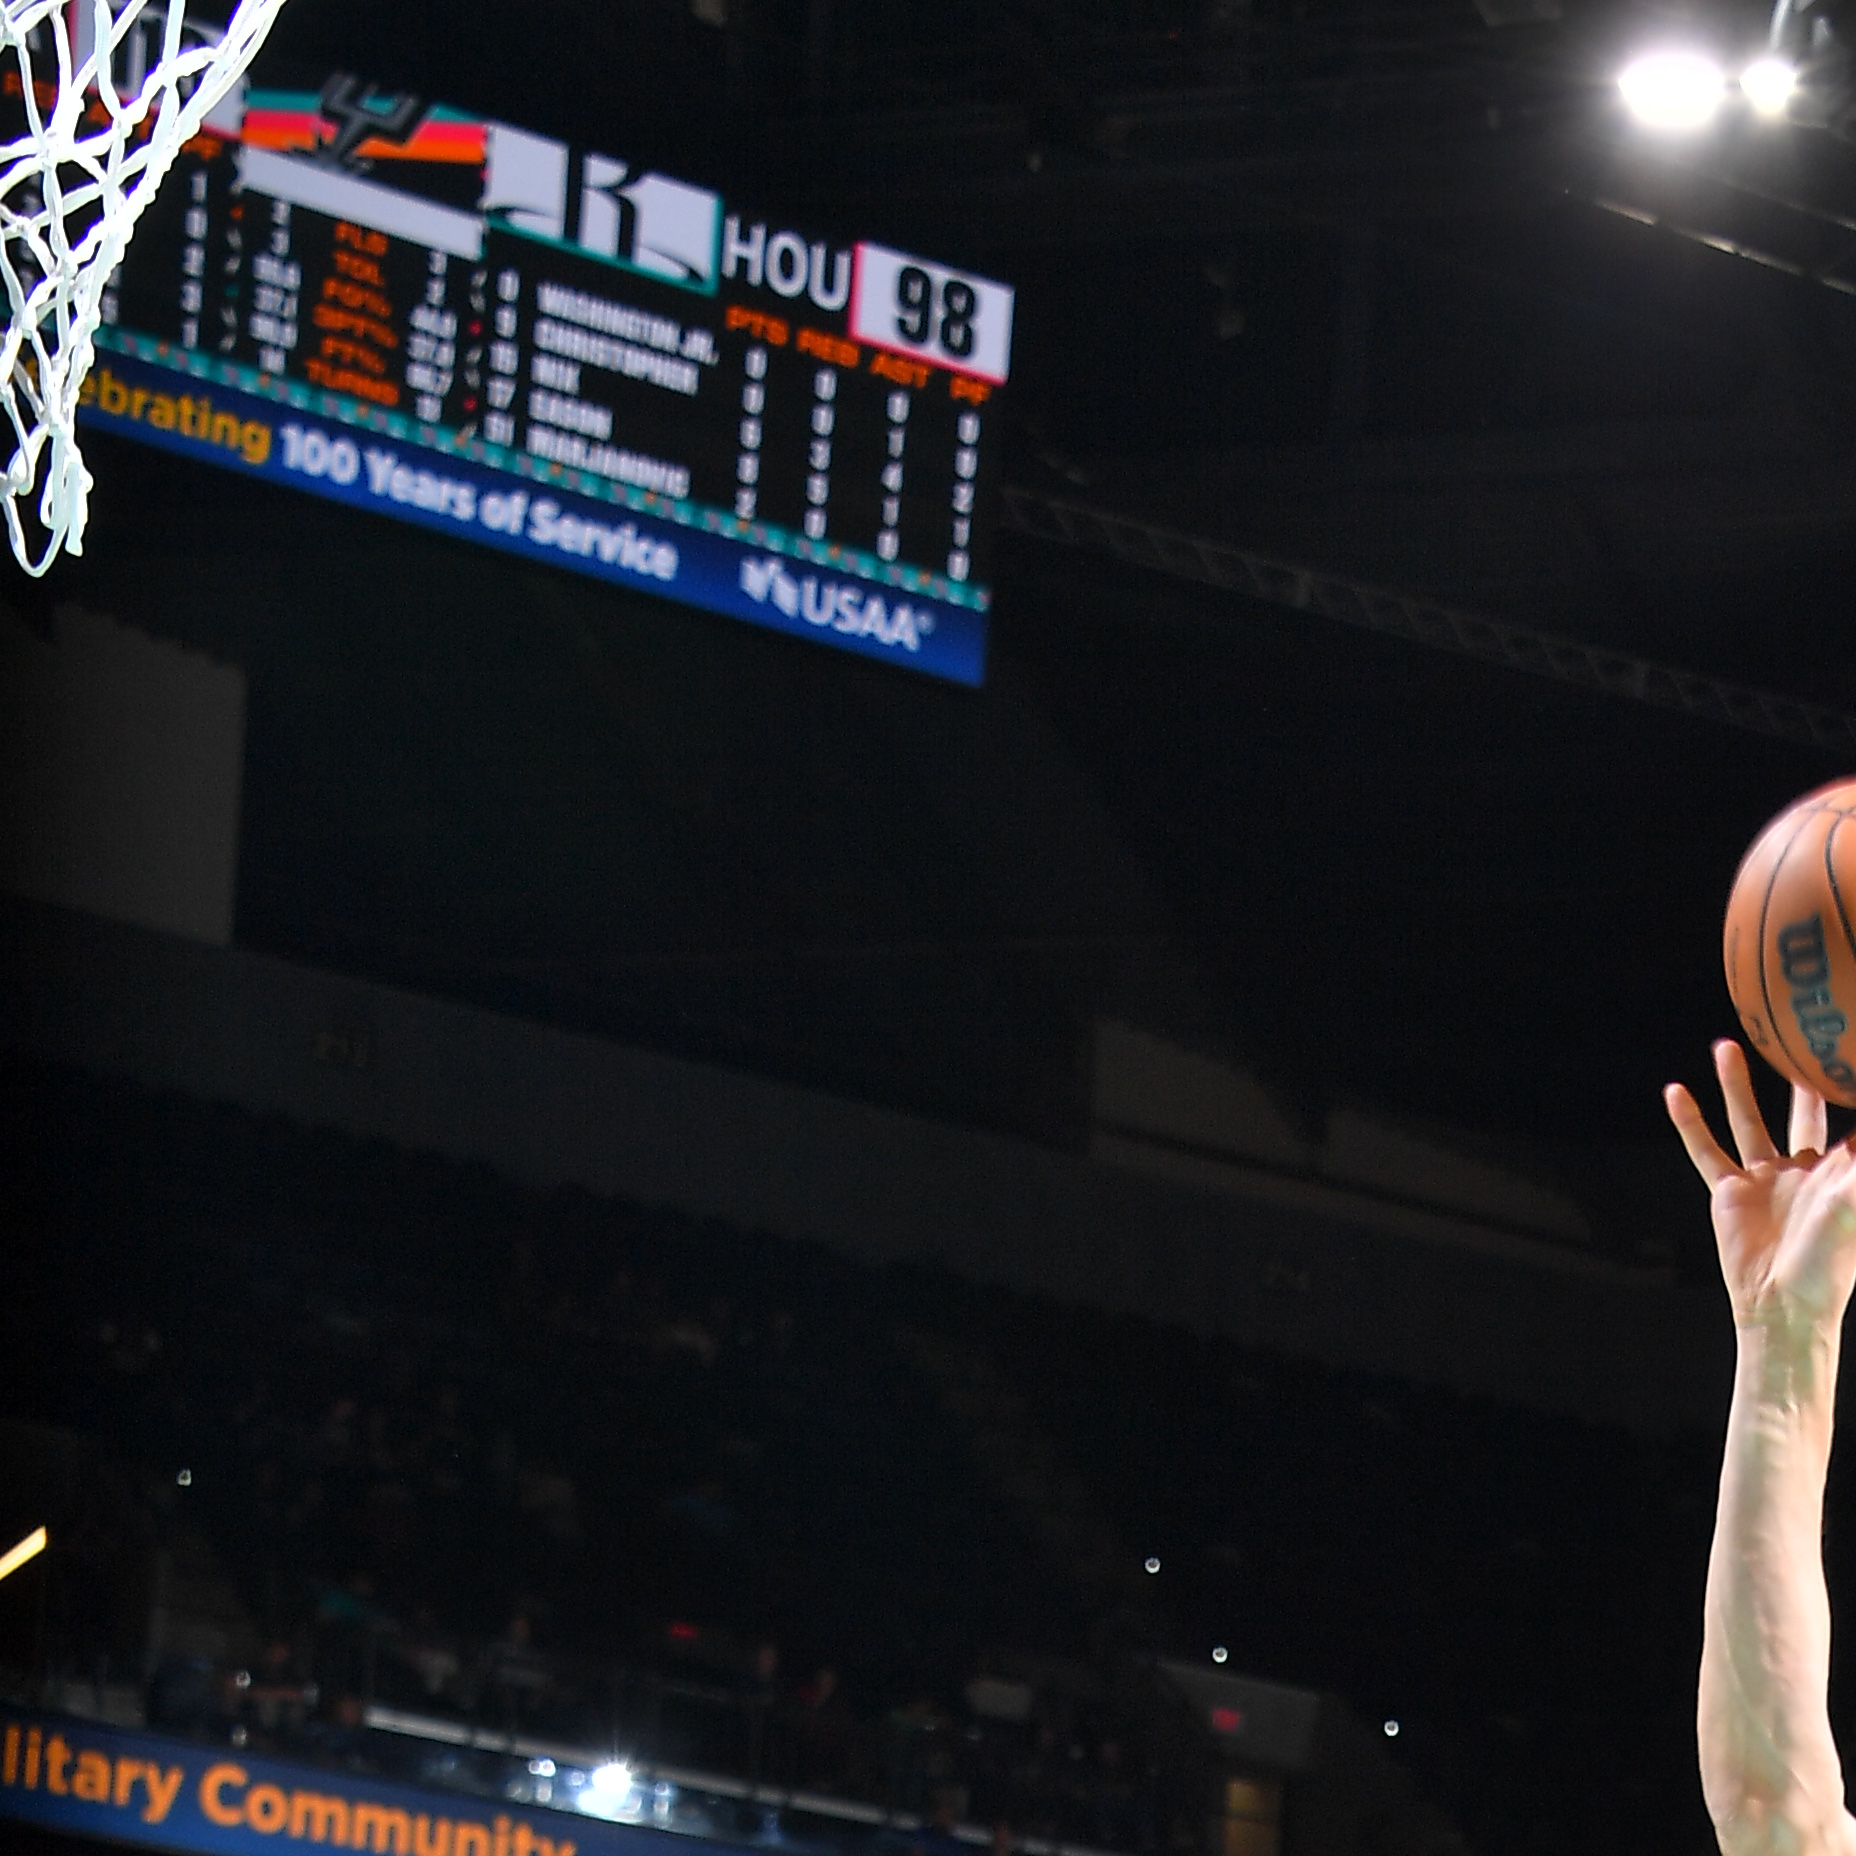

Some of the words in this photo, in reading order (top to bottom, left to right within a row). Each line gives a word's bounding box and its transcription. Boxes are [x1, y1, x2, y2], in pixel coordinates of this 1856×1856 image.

[721, 215, 852, 312] HOU
[896, 265, 976, 359] 98
[279, 421, 360, 486] 100
[363, 447, 478, 522] Years
[478, 490, 530, 536] of
[528, 499, 680, 583] Service
[799, 574, 922, 653] USAA
